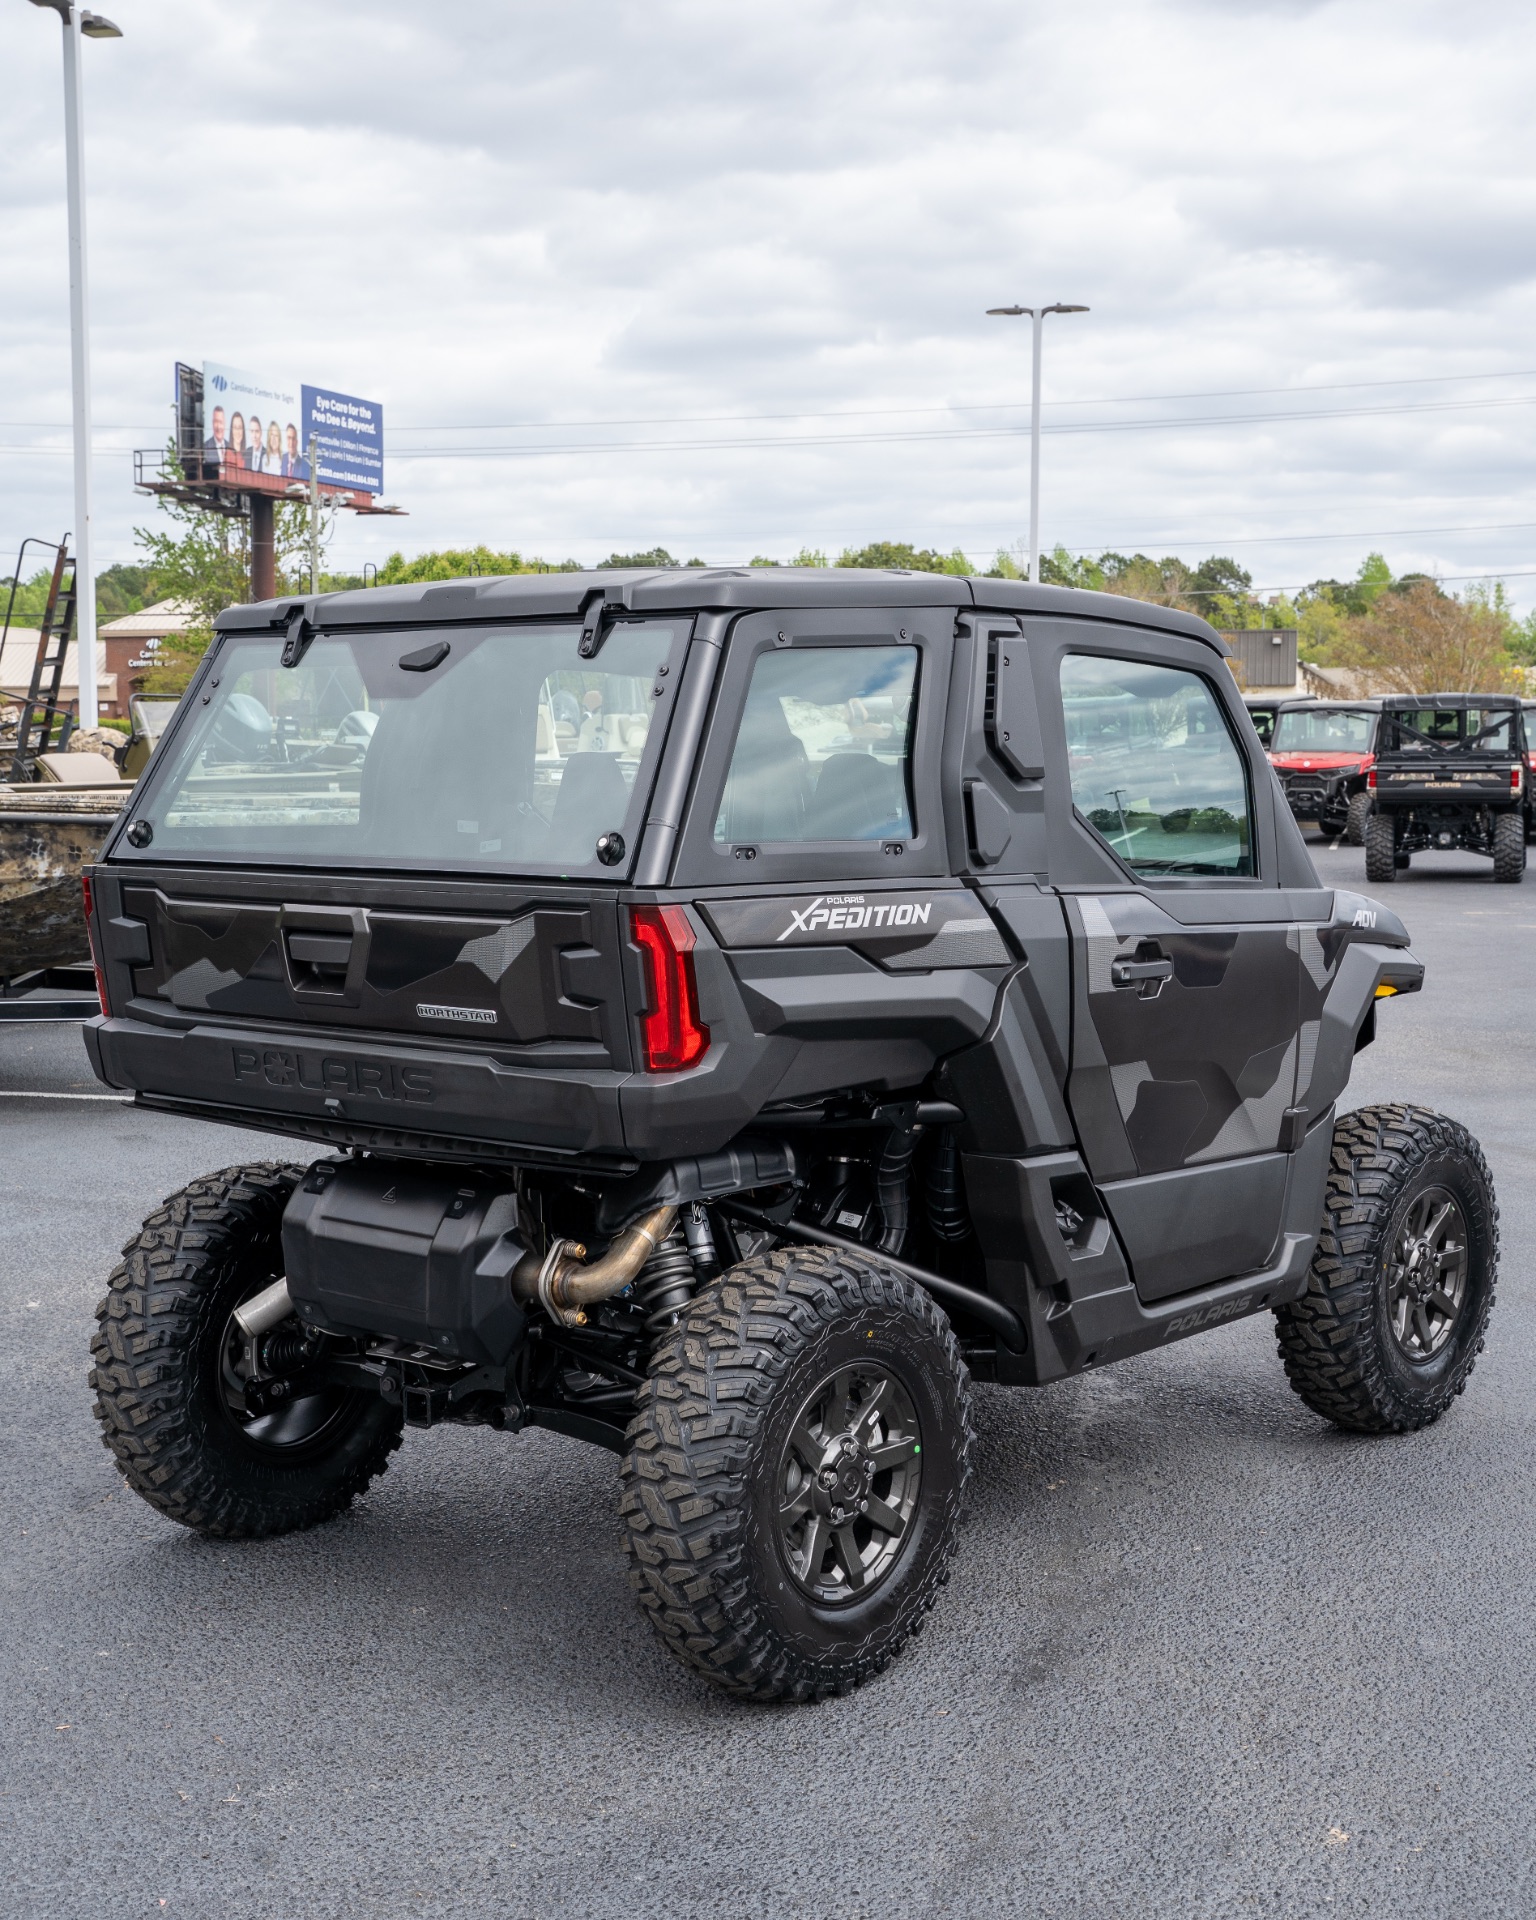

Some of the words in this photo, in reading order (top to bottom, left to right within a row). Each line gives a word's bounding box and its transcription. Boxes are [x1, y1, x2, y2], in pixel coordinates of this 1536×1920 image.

[316, 395, 330, 411] Eye
[330, 399, 348, 414] Care
[348, 402, 359, 416] for
[359, 406, 372, 420] the
[311, 409, 326, 423] Pee
[326, 412, 340, 427] Dee
[340, 416, 347, 428] &
[347, 417, 376, 435] Beyond.
[128, 659, 153, 668] Centers
[826, 895, 865, 905] POLARIS
[776, 897, 932, 941] XPEDITION
[1351, 909, 1377, 929] ADV
[419, 1006, 492, 1021] NORTHSTAR
[231, 1046, 438, 1105] POLARIS
[1162, 1293, 1254, 1338] POLARIS
